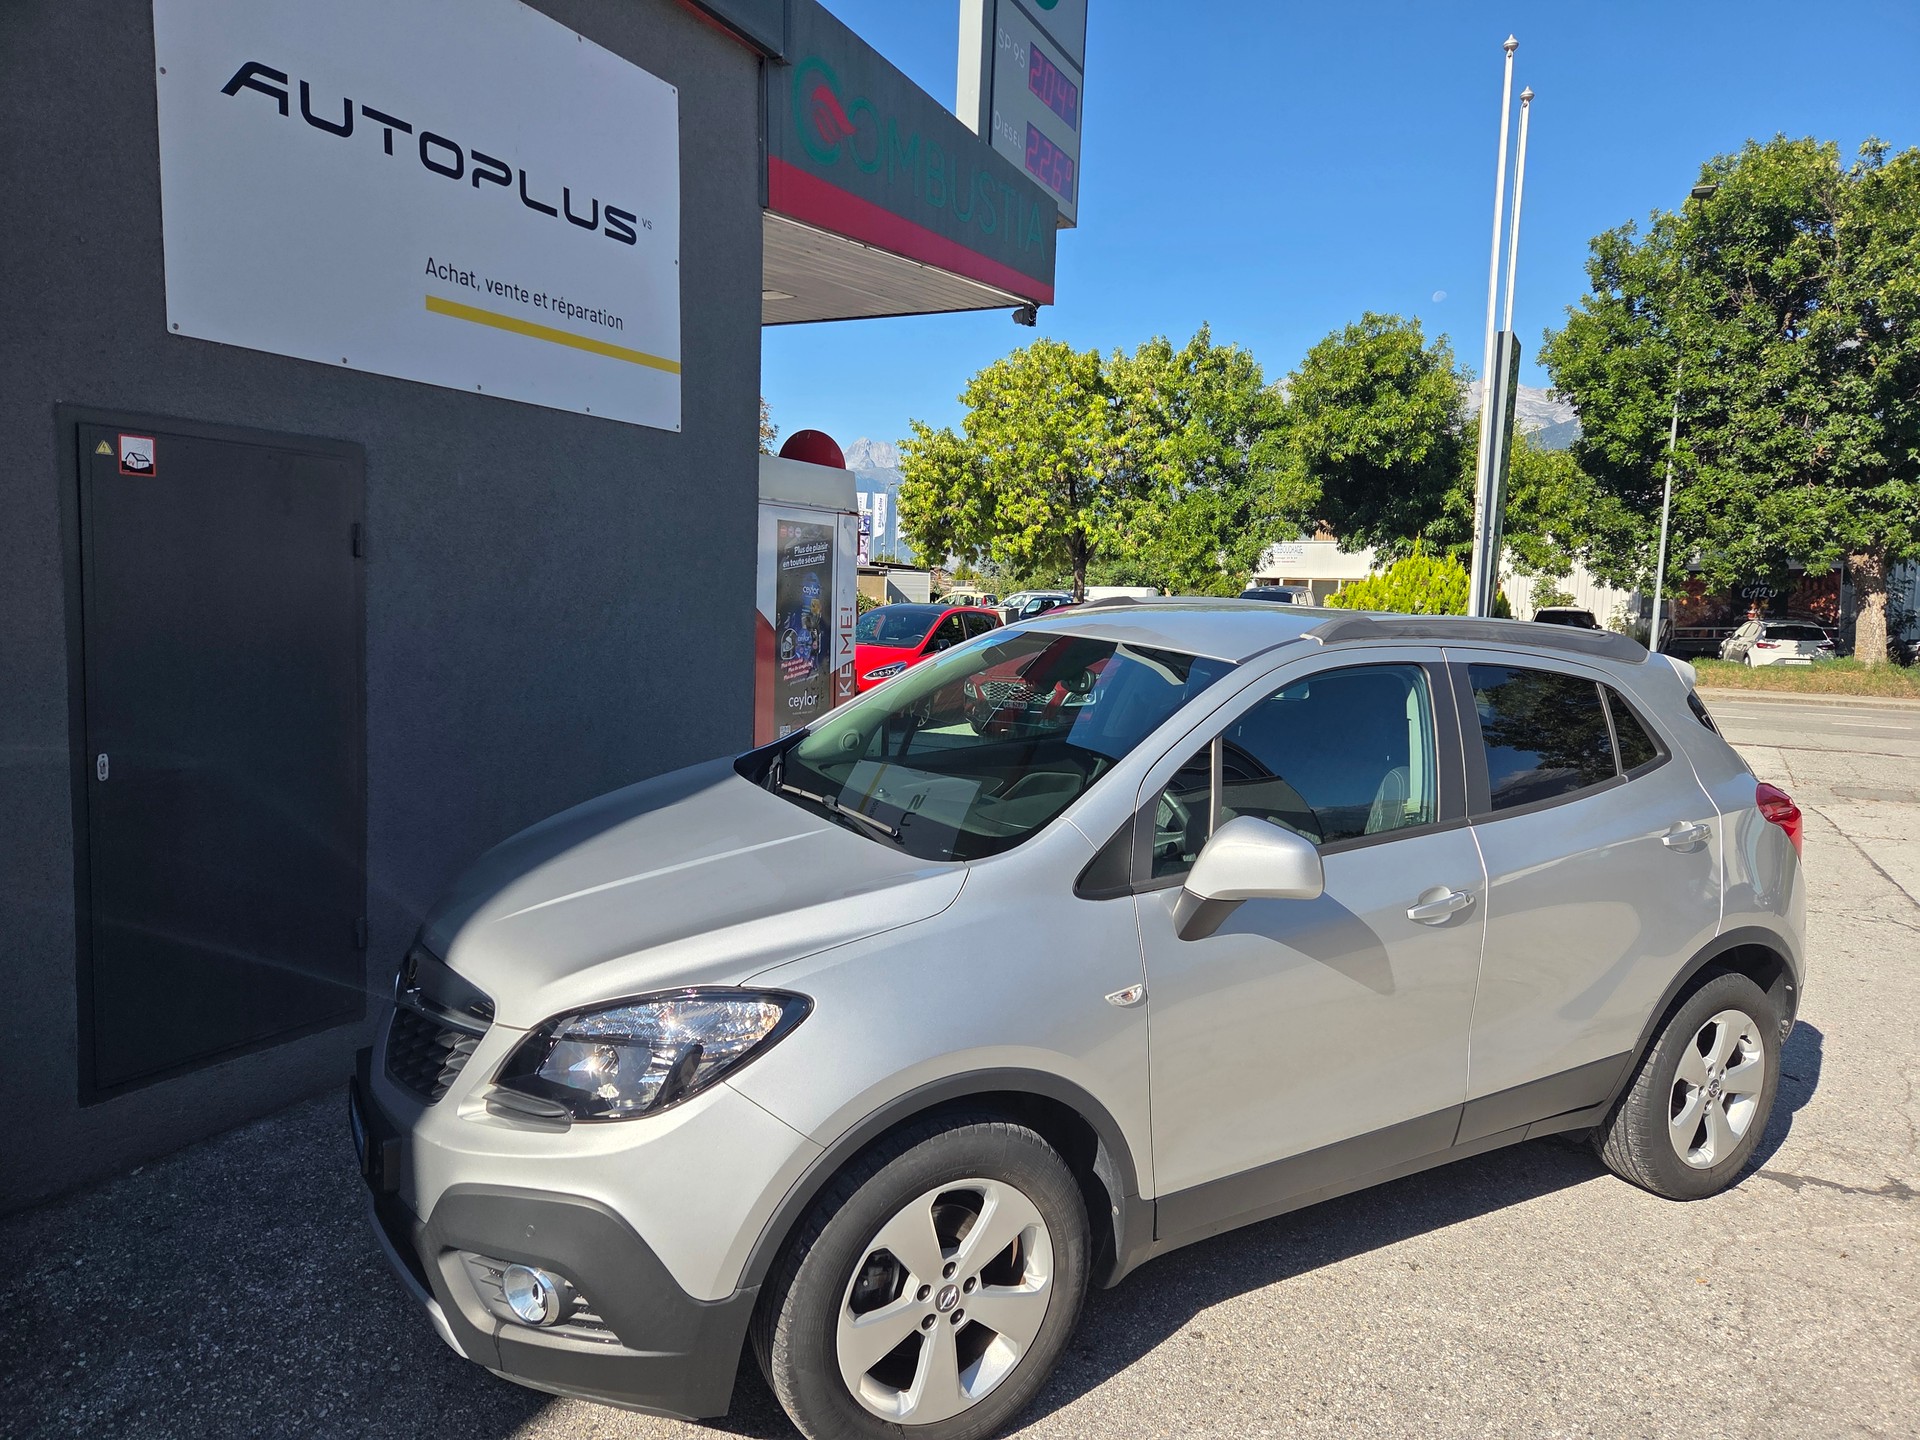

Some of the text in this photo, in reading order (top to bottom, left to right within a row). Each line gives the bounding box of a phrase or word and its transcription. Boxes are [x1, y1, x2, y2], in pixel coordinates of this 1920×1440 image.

[998, 27, 1026, 68] SP 95
[994, 110, 1022, 149] DIESEL
[220, 61, 653, 246] AUTOPLUS VS
[792, 56, 1045, 261] COMBUSTIA
[425, 257, 624, 332] Achat, vente et réparation
[790, 558, 804, 567] toute
[804, 553, 825, 564] sécurité
[794, 542, 828, 554] Plus de plaisir
[802, 584, 819, 596] ceylor
[840, 607, 852, 654] ME!
[788, 690, 817, 709] ceylor
